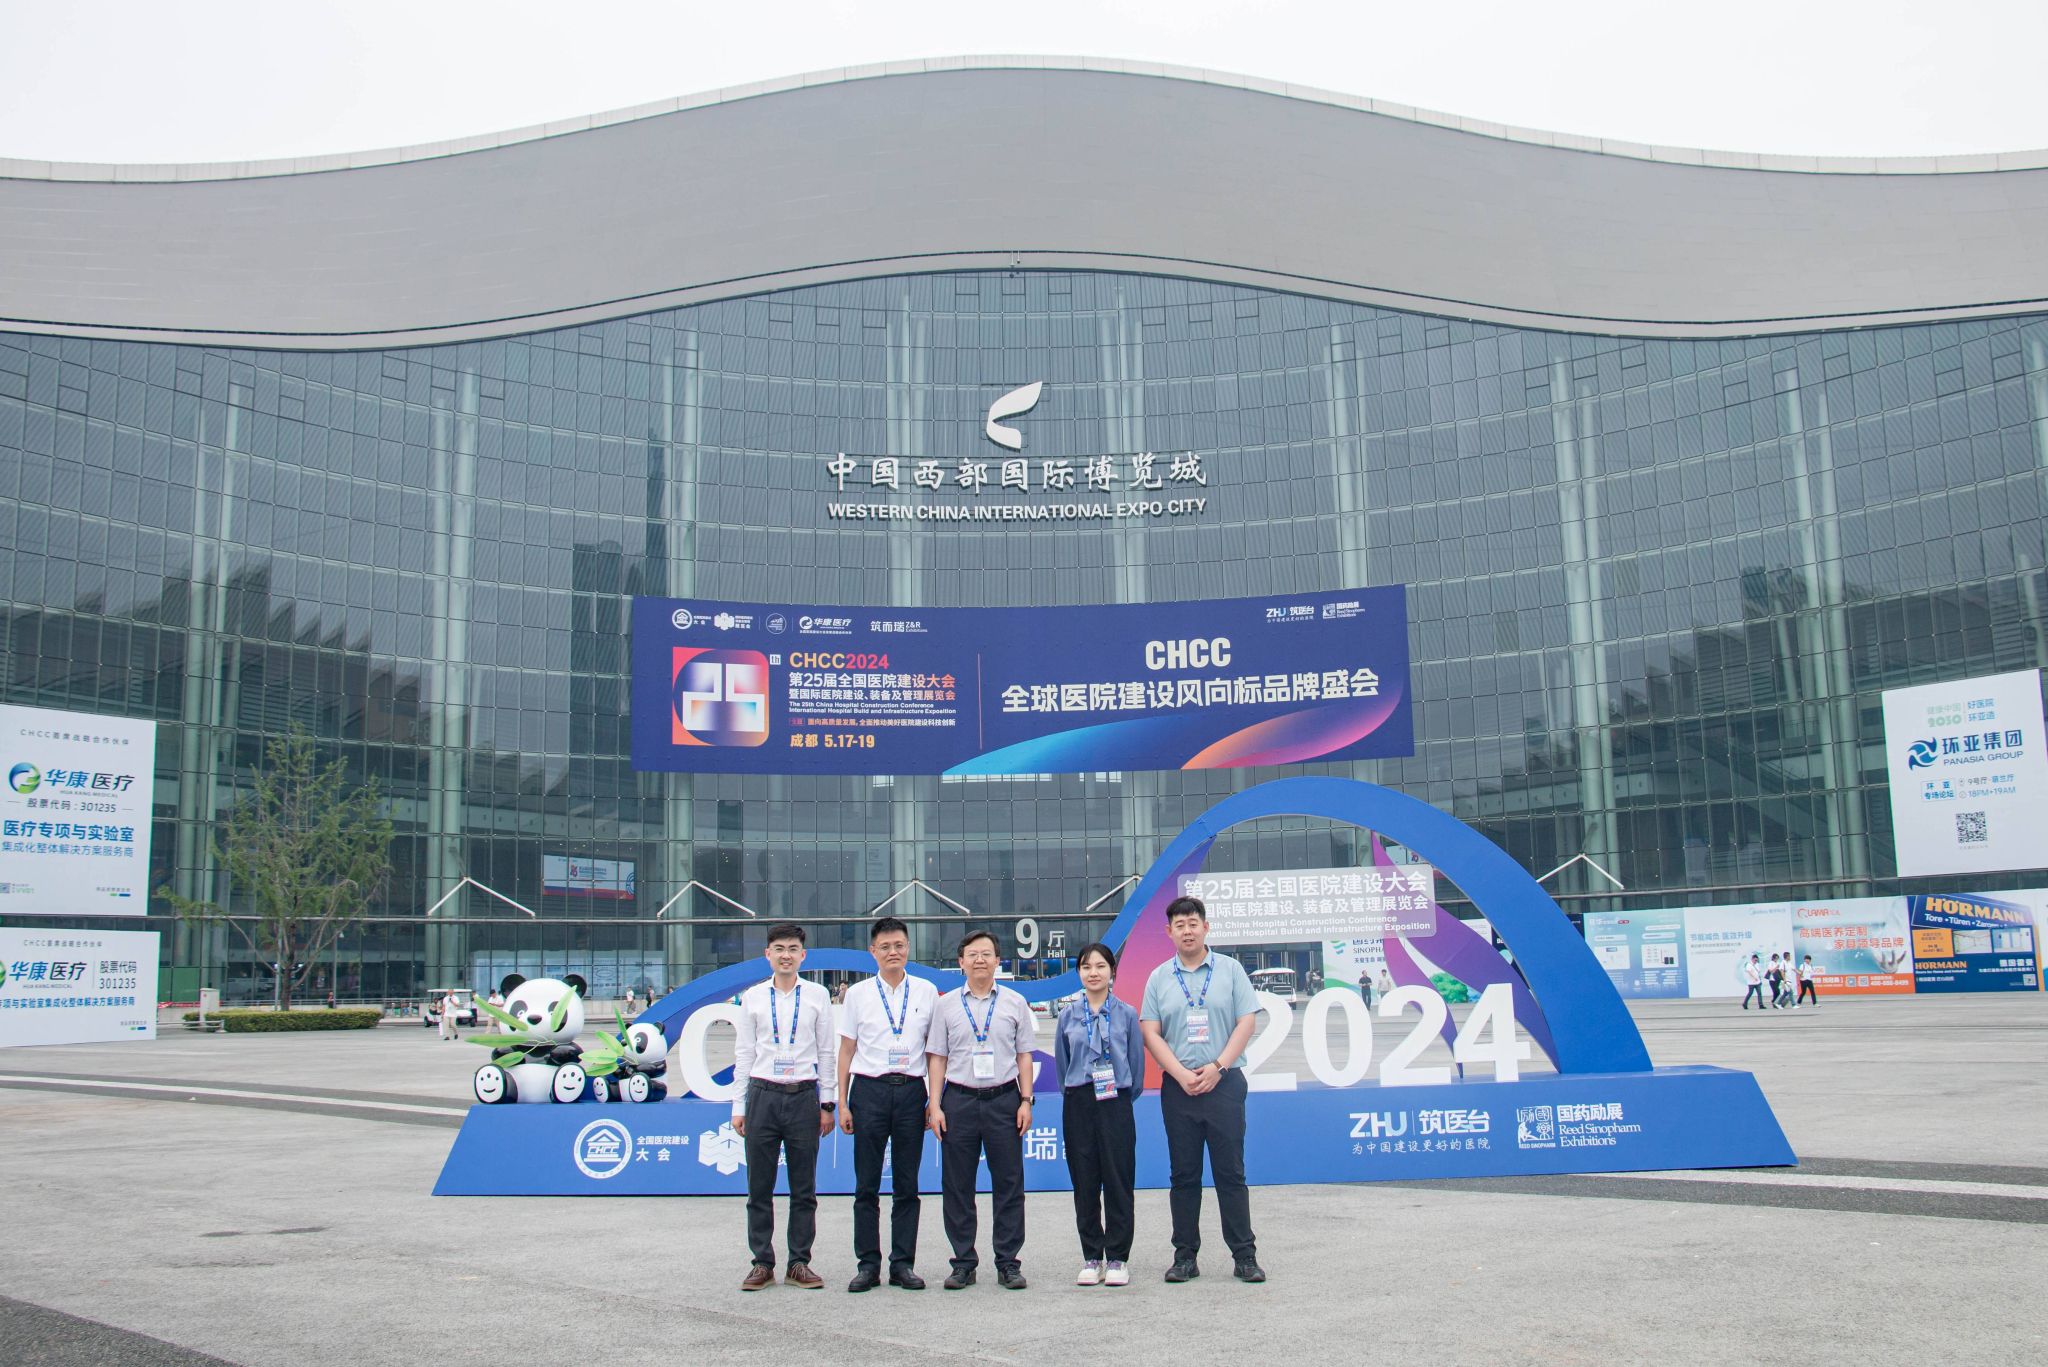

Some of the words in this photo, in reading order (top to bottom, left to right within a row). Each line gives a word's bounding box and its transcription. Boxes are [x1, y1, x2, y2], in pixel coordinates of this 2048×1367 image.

[827, 451, 1207, 495] 中国西部国际博览城
[828, 503, 913, 519] WESTERN
[916, 505, 971, 520] CHINA
[974, 503, 1113, 520] INTERNATIONAL
[1116, 501, 1164, 517] EXPO
[1167, 498, 1207, 514] CITY
[814, 618, 852, 627] 华康医疗
[870, 621, 905, 632] 筑而瑞
[789, 652, 889, 669] CHCC2024
[1145, 637, 1231, 670] CHCC
[789, 672, 956, 688] 第25届全国医院建设大会
[789, 689, 956, 700] 暨国际医院建设、装备及管理展览会
[1002, 667, 1379, 713] 全球医院建设风向标品牌盛会
[790, 733, 818, 748] 成都
[824, 734, 875, 748] 5.17-19
[1942, 729, 2023, 755] 环亚集团
[1943, 755, 1985, 766] PANASIA
[1987, 750, 2024, 761] GROUP
[44, 768, 135, 792] 华康医疗
[3, 819, 135, 842] 医疗专项与实验室
[2, 841, 134, 858] 集成化整体解决方案服务商
[1184, 871, 1427, 900] 第25届全国医院建设大会
[1205, 894, 1428, 918] 国际医院建设、装备及管理展览会
[1252, 918, 1288, 929] Hospital
[1290, 917, 1346, 926] Construction
[1349, 915, 1398, 924] Conference
[1925, 913, 1943, 922] Tore
[1949, 916, 1971, 926] Türen
[1207, 929, 1240, 938] national
[1243, 928, 1278, 938] Hospital
[1281, 927, 1303, 936] Build
[1305, 926, 1321, 934] and
[1324, 924, 1383, 933] Infrastructure
[1385, 921, 1430, 932] Exposition
[1015, 918, 1040, 959] 9
[1047, 930, 1065, 947] 厅
[1047, 949, 1066, 958] Hall
[1353, 946, 1384, 954] SINOPH
[9, 961, 88, 981] 华康医疗
[100, 961, 137, 974] 股票代码
[100, 978, 137, 989] 301235
[1244, 983, 1531, 1091] 2024
[1557, 1103, 1624, 1122] 国药励展
[1418, 1109, 1490, 1135] 筑医台
[1559, 1124, 1585, 1135] Reed
[1585, 1122, 1641, 1137] Sinopharm
[637, 1136, 689, 1145] 全国医院建设
[1352, 1137, 1491, 1155] 为中国建设更好的医院
[1560, 1135, 1617, 1147] Exhibitions
[635, 1148, 671, 1162] 大会
